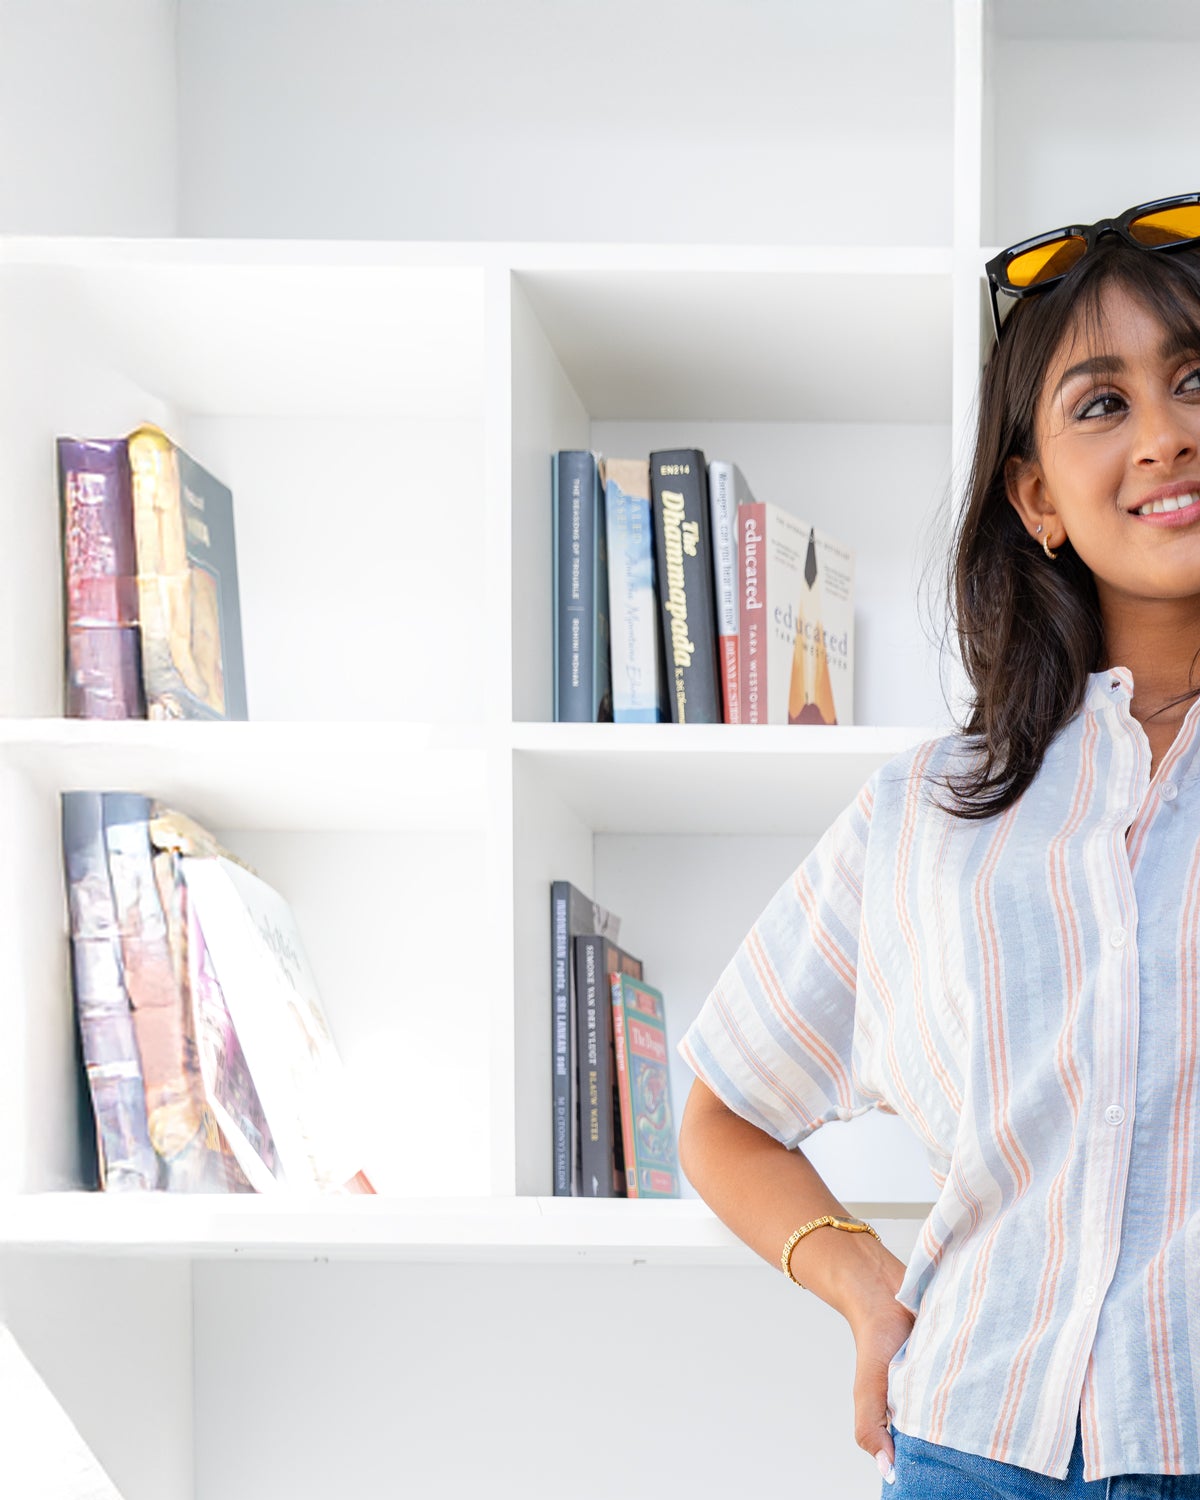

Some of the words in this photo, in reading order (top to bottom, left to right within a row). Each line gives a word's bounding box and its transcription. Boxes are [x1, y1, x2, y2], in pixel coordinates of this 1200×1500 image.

[571, 478, 581, 496] THE
[660, 464, 690, 476] EN214
[571, 542, 581, 555] OF
[682, 521, 700, 557] The
[571, 557, 581, 599] TROUBLE
[661, 490, 696, 667] Dhammapada
[744, 519, 763, 610] educated
[749, 624, 759, 656] TARA
[774, 604, 848, 657] educated
[749, 659, 759, 724] WESTOVER
[585, 945, 595, 984] SIMONE
[556, 995, 567, 1012] SRI
[586, 986, 596, 1006] VAN
[587, 1008, 596, 1029] DER
[588, 1031, 597, 1065] VLUGT
[589, 1071, 598, 1105] BLAUW
[590, 1108, 599, 1141] WATER
